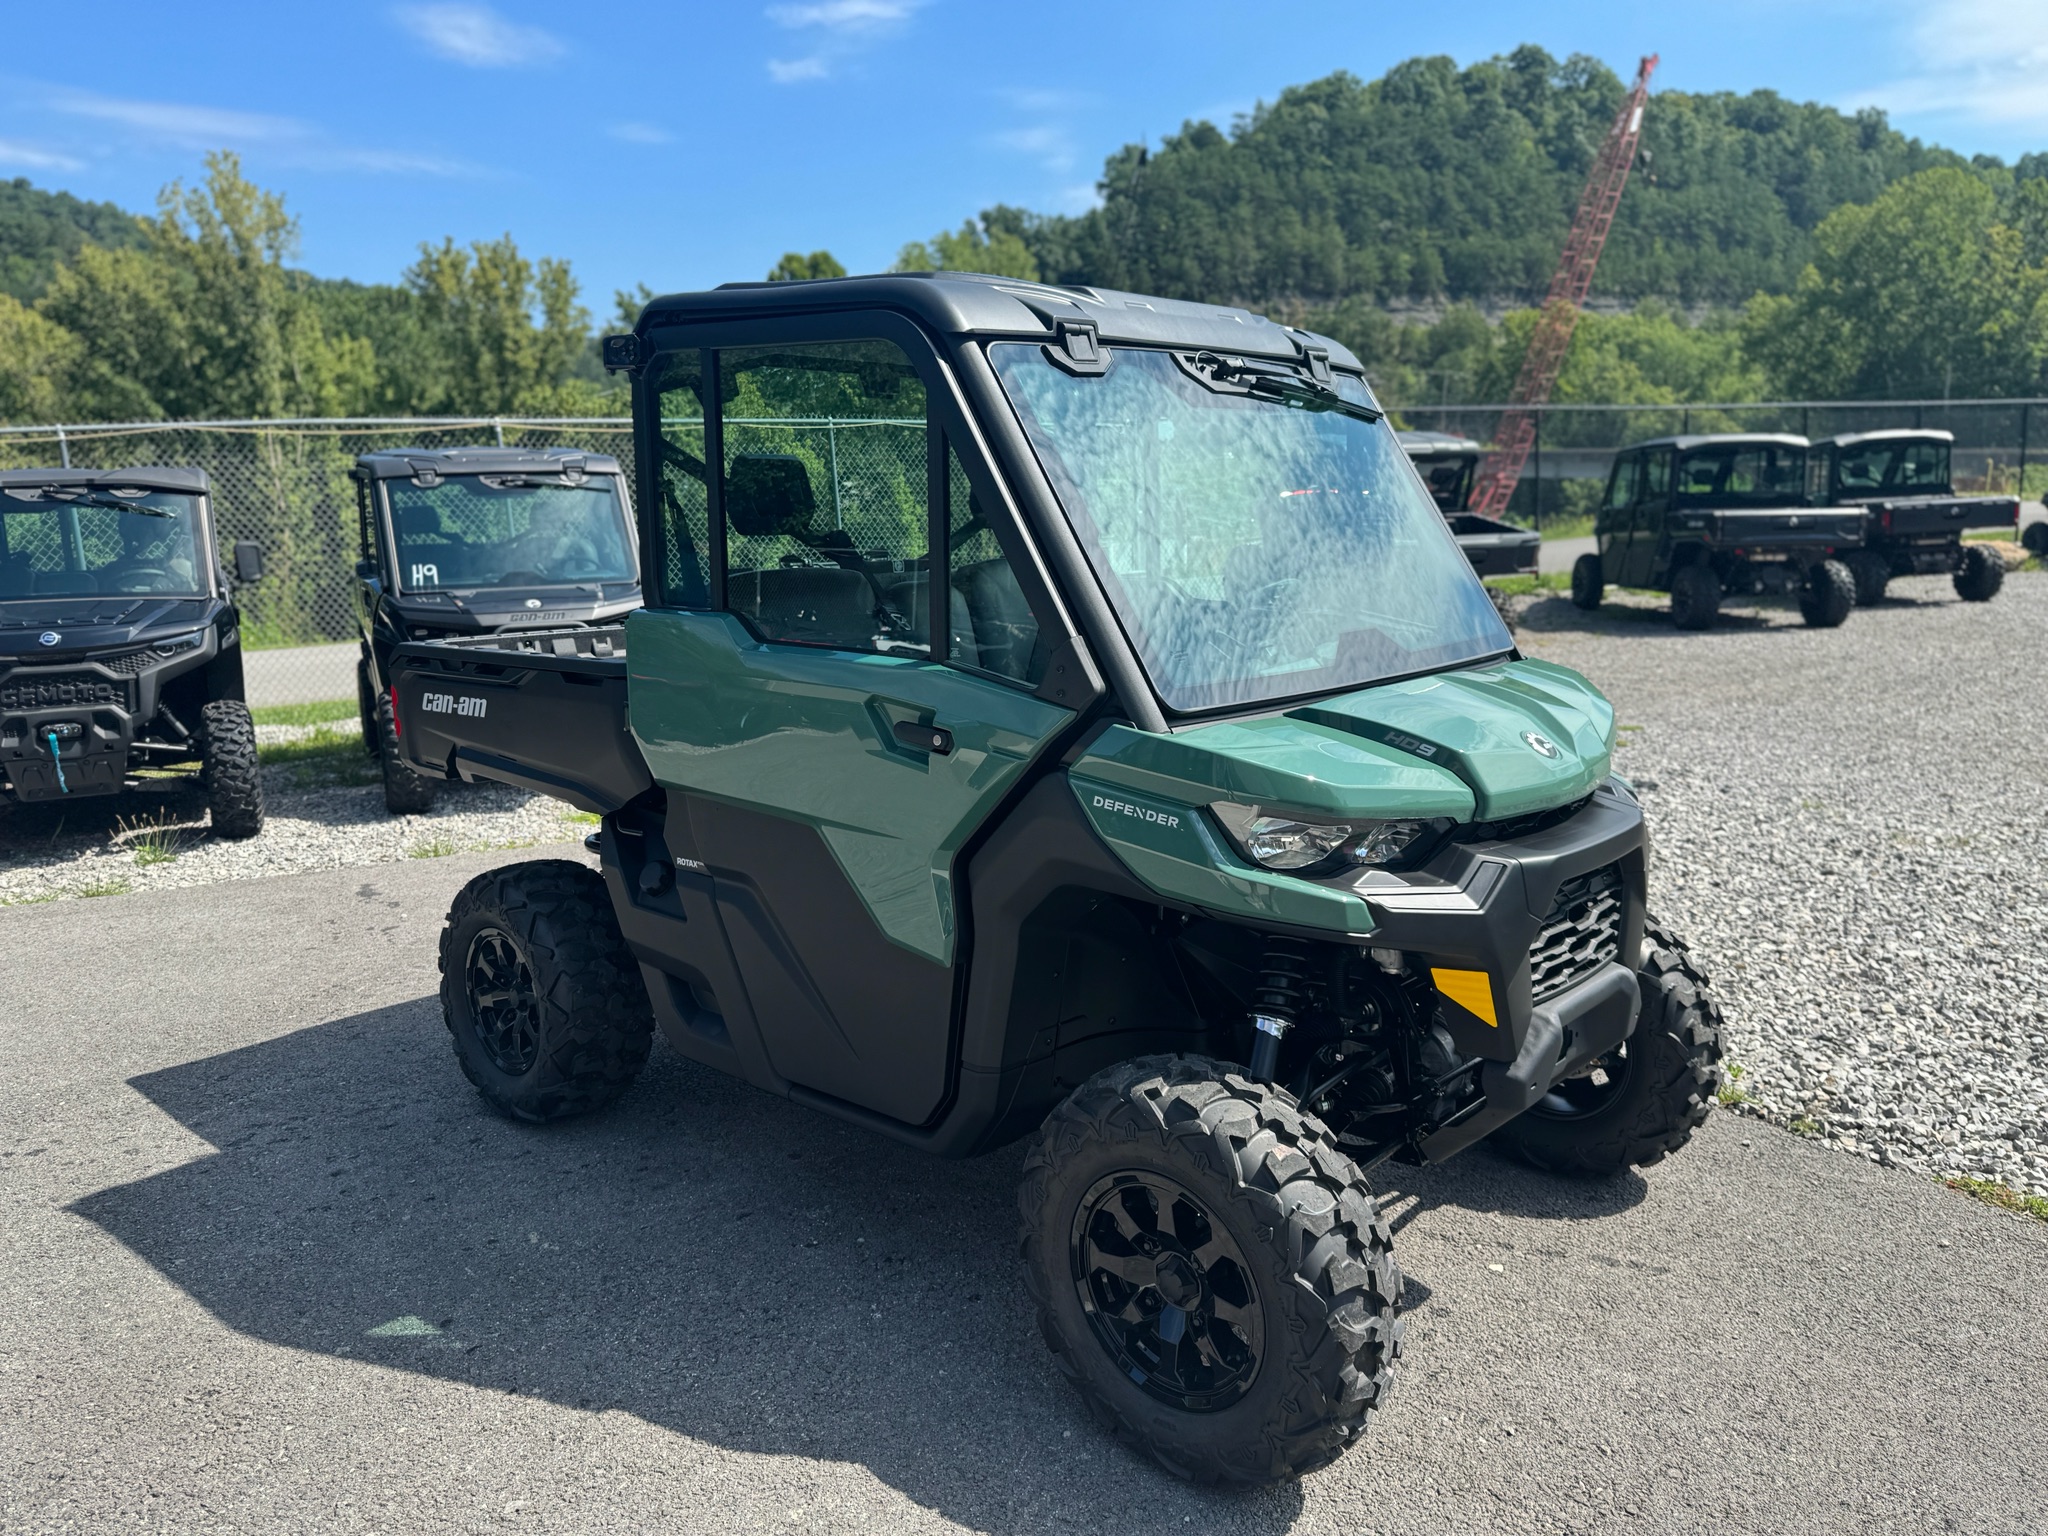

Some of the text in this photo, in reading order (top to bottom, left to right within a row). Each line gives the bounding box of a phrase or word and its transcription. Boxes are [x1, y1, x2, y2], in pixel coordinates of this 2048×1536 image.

[411, 563, 440, 587] H9
[1, 683, 112, 703] CFMOTO
[422, 692, 487, 718] can-am
[1384, 731, 1437, 757] HD9
[1093, 795, 1180, 829] DEFENDER
[676, 857, 698, 868] ROTAX
